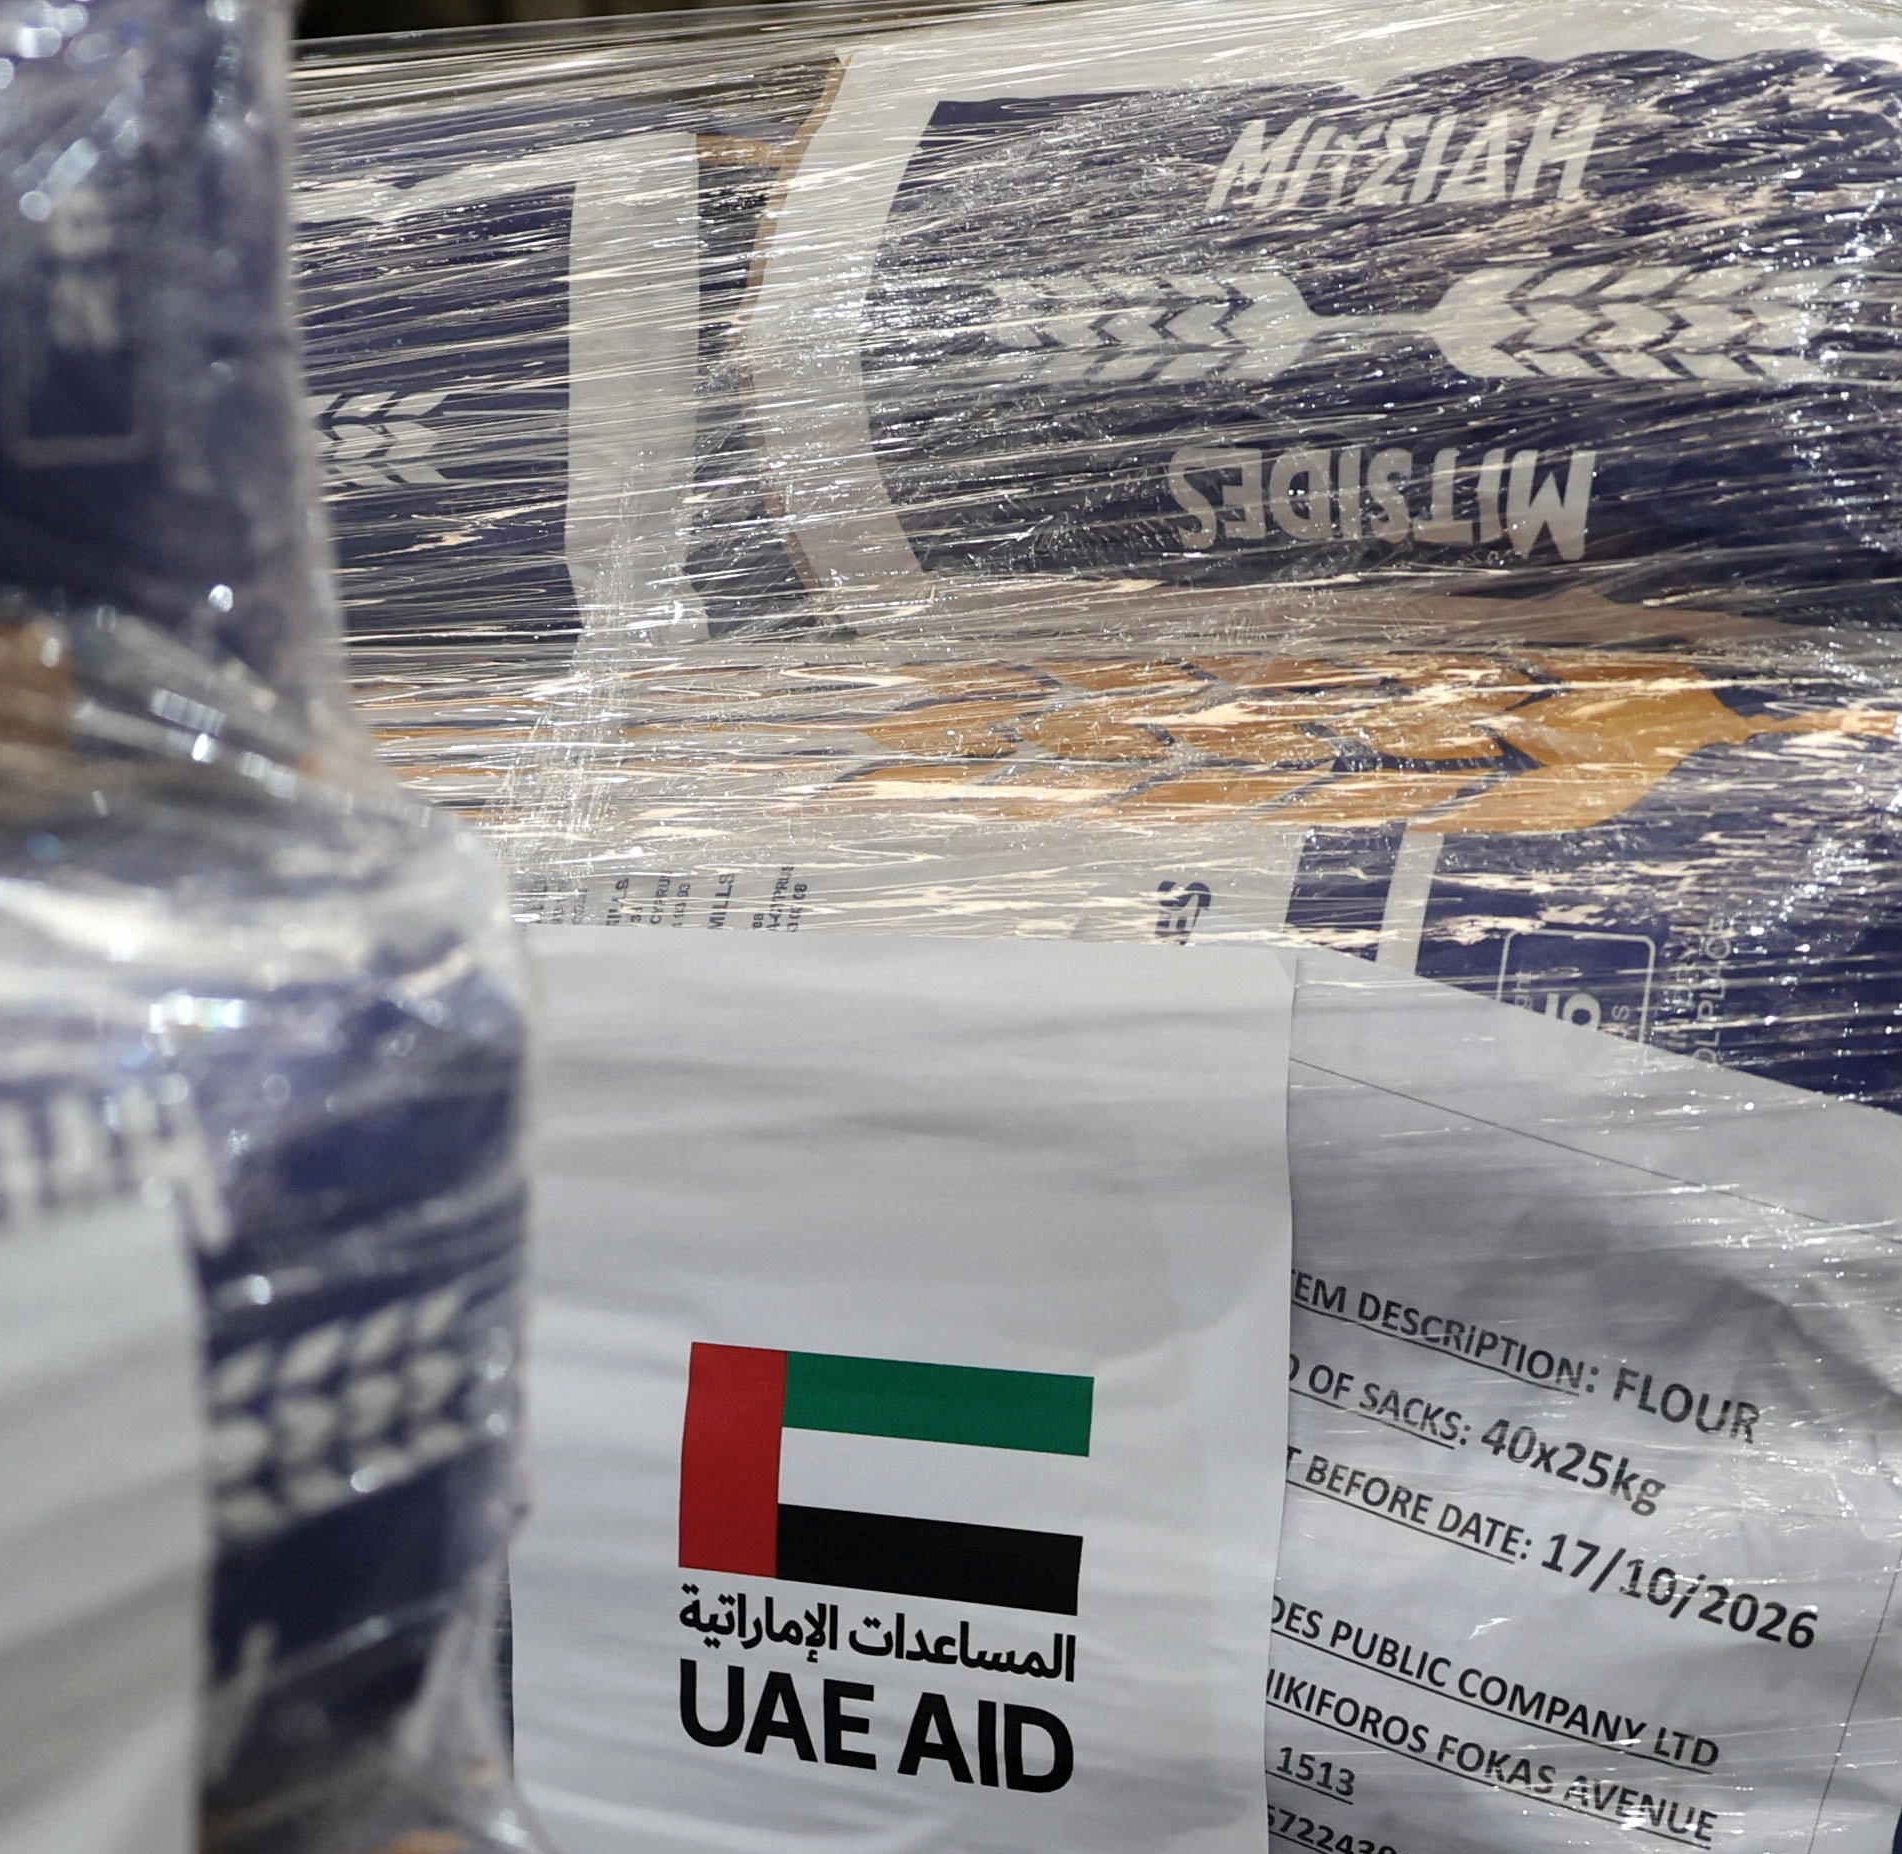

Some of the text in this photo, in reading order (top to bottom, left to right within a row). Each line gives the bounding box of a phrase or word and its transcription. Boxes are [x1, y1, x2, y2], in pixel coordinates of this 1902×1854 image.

[1166, 447, 1596, 563] MITSIDES
[1290, 1268, 1761, 1444] EM DESCRIPTION: FLOUR
[1308, 1363, 1355, 1401] OF
[1359, 1381, 1473, 1446] SACKS:
[1480, 1418, 1667, 1517] 40x25kg
[1304, 1454, 1434, 1527] BEFORE
[1436, 1503, 1533, 1563] DATE:
[1540, 1531, 1819, 1650] 17/10/2026
[678, 1583, 1076, 1683] المساعدات الإماراتية
[1328, 1619, 1452, 1689] PUBLIC
[1457, 1668, 1648, 1744] COMPANY
[1653, 1726, 1720, 1769] LTD
[679, 1658, 1075, 1794] UAE AID
[1275, 1746, 1356, 1798] 1513
[1436, 1734, 1557, 1795] FOKAS
[1562, 1775, 1718, 1843] AVENUE
